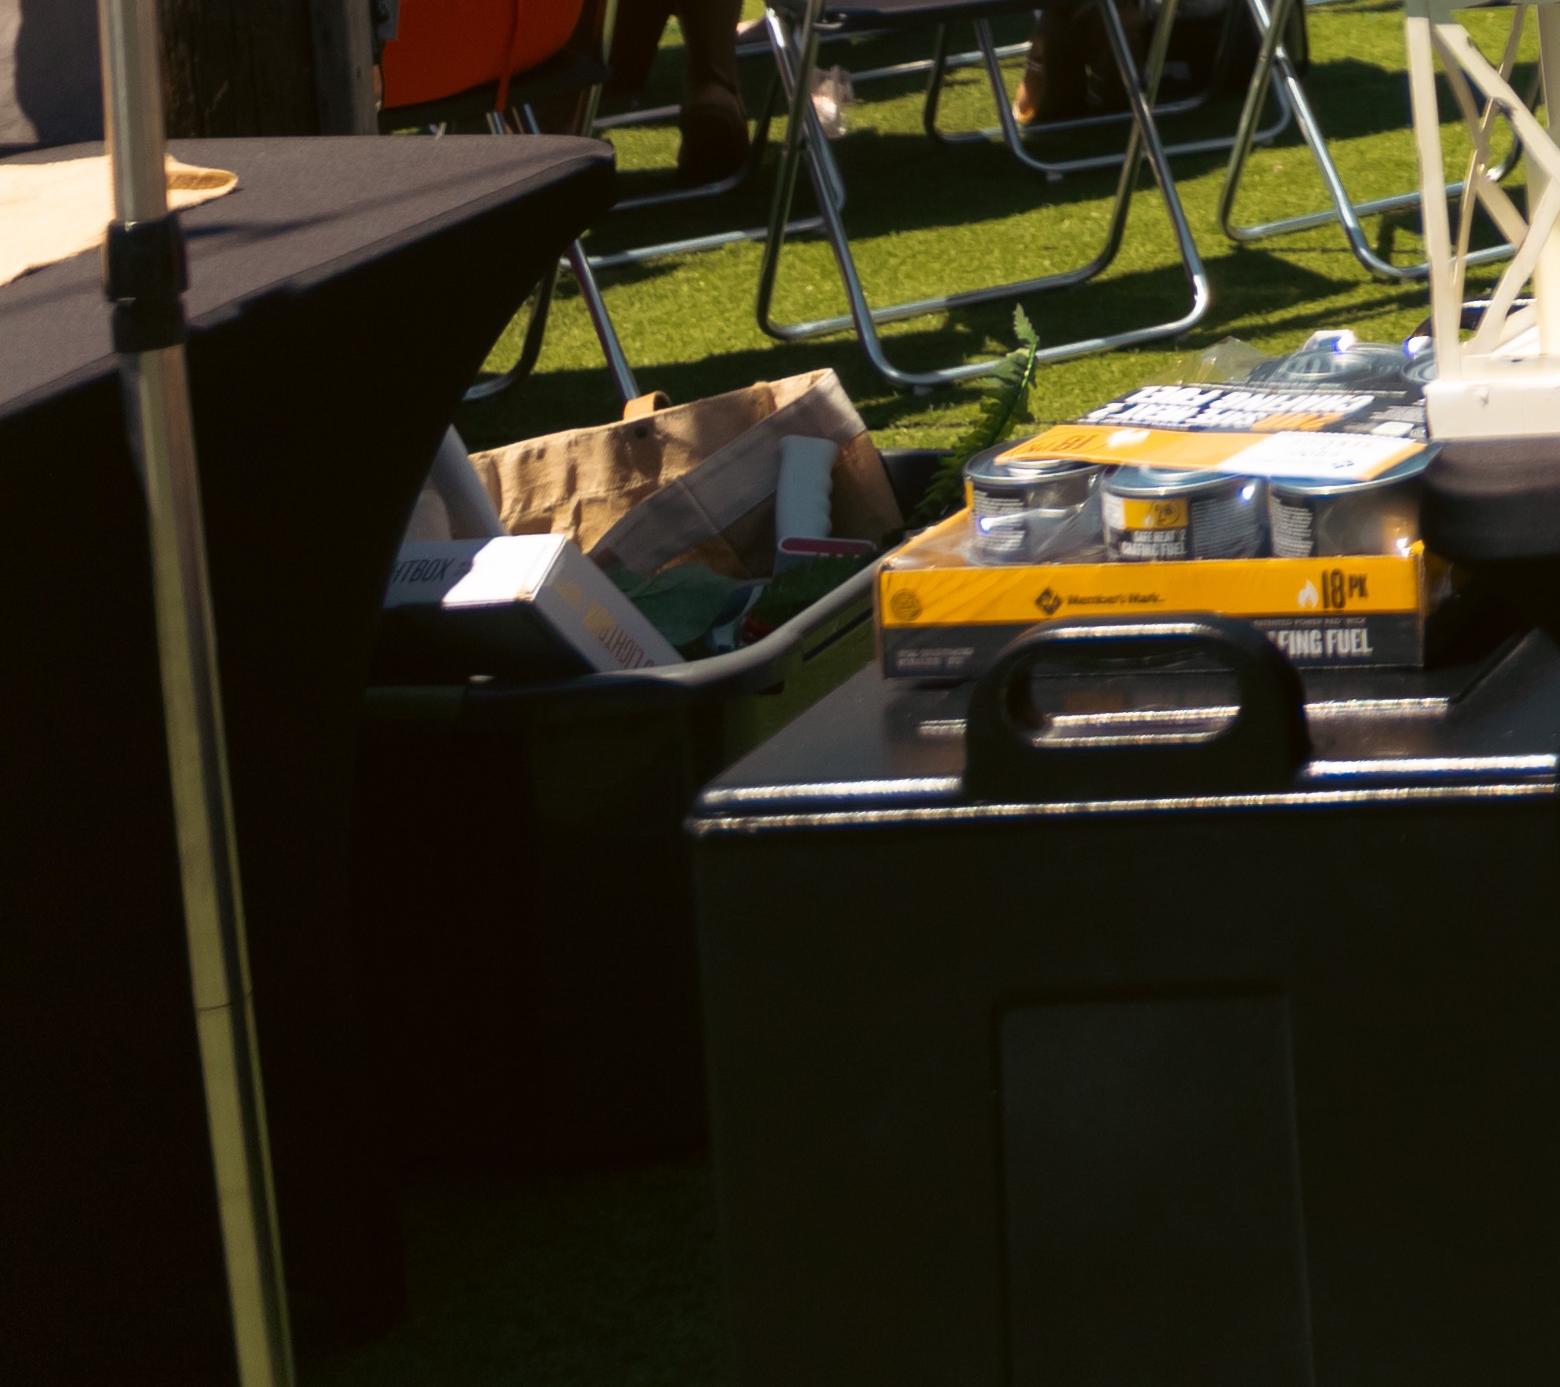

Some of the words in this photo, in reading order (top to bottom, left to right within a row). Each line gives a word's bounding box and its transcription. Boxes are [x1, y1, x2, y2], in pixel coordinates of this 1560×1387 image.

[1160, 540, 1187, 555] FUEL
[1321, 569, 1347, 610] 18
[1349, 573, 1369, 599] PK
[1266, 629, 1322, 658] FING
[1325, 627, 1374, 657] FUEL
